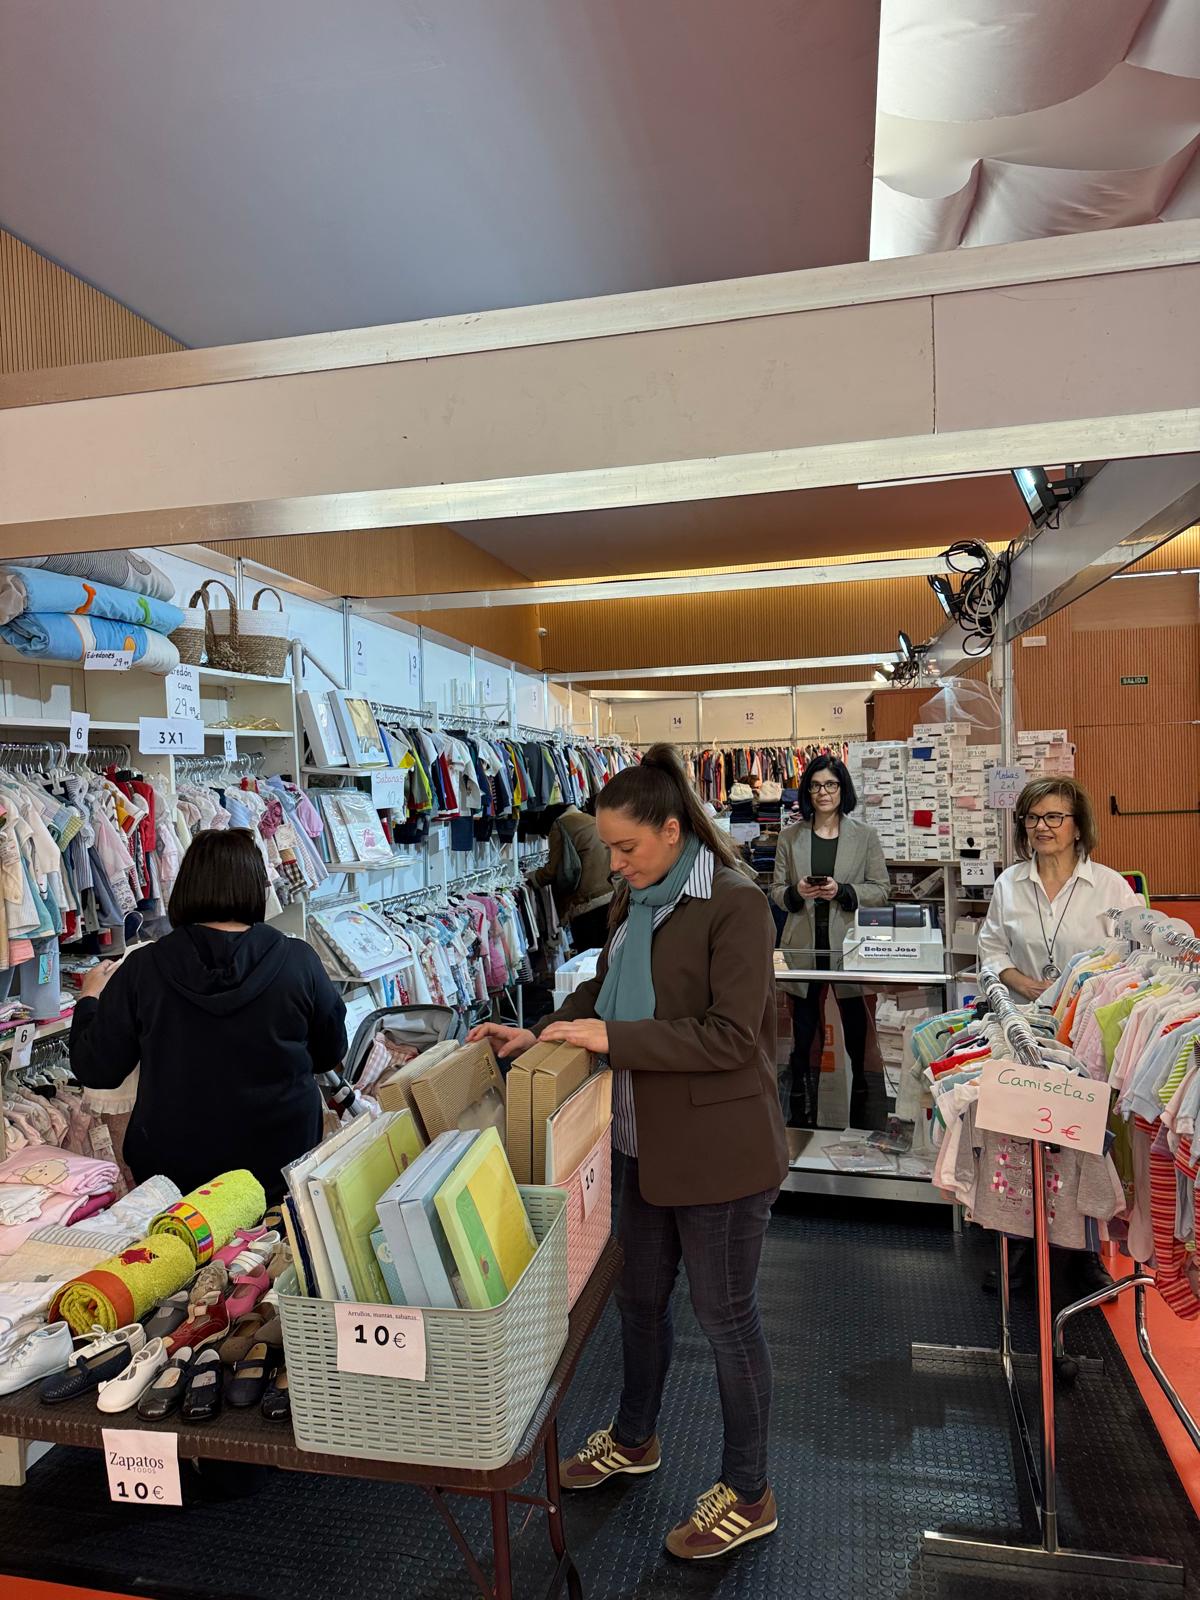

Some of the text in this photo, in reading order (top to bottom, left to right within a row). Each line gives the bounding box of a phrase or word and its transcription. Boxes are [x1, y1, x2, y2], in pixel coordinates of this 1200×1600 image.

[357, 640, 363, 656] 2
[1122, 677, 1147, 685] SALIDA
[745, 712, 755, 721] 12
[832, 706, 844, 716] 10
[673, 716, 682, 725] 14
[76, 727, 83, 741] 6
[20, 1029, 29, 1043] 6
[997, 1068, 1097, 1103] Camisetas
[585, 1167, 595, 1191] 10
[109, 1450, 165, 1471] Zapatos
[132, 1466, 157, 1475] TODOS
